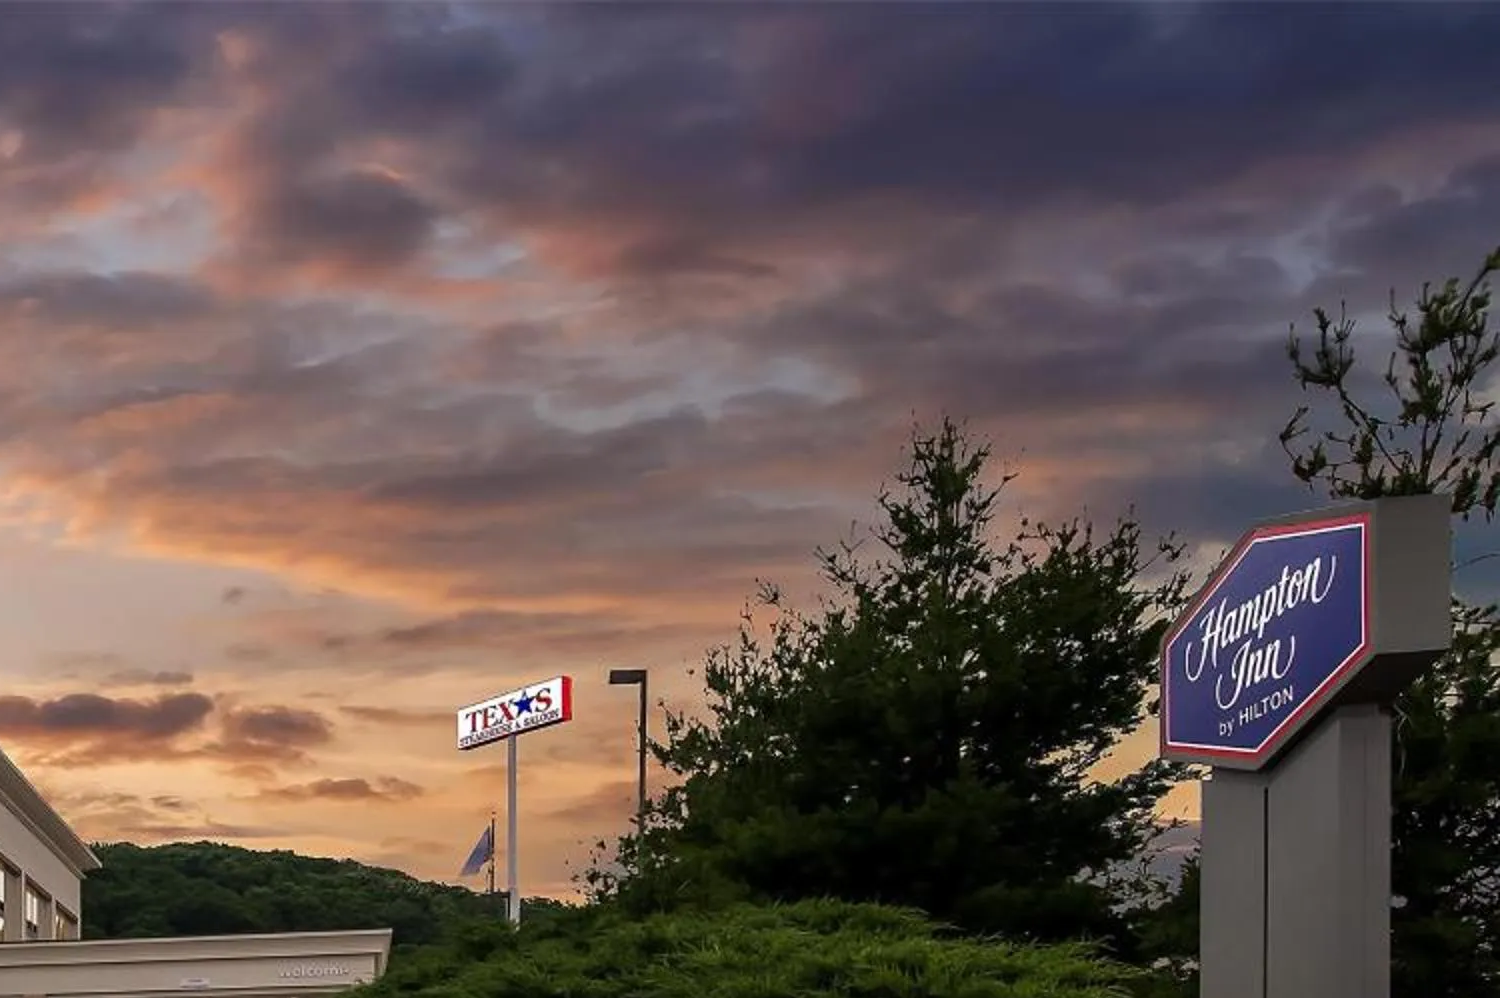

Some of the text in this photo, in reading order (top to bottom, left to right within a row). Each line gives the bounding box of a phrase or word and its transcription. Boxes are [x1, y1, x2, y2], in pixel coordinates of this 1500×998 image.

[1185, 555, 1336, 681] Hampton
[1216, 636, 1295, 709] Inn
[1239, 684, 1293, 726] HILTON
